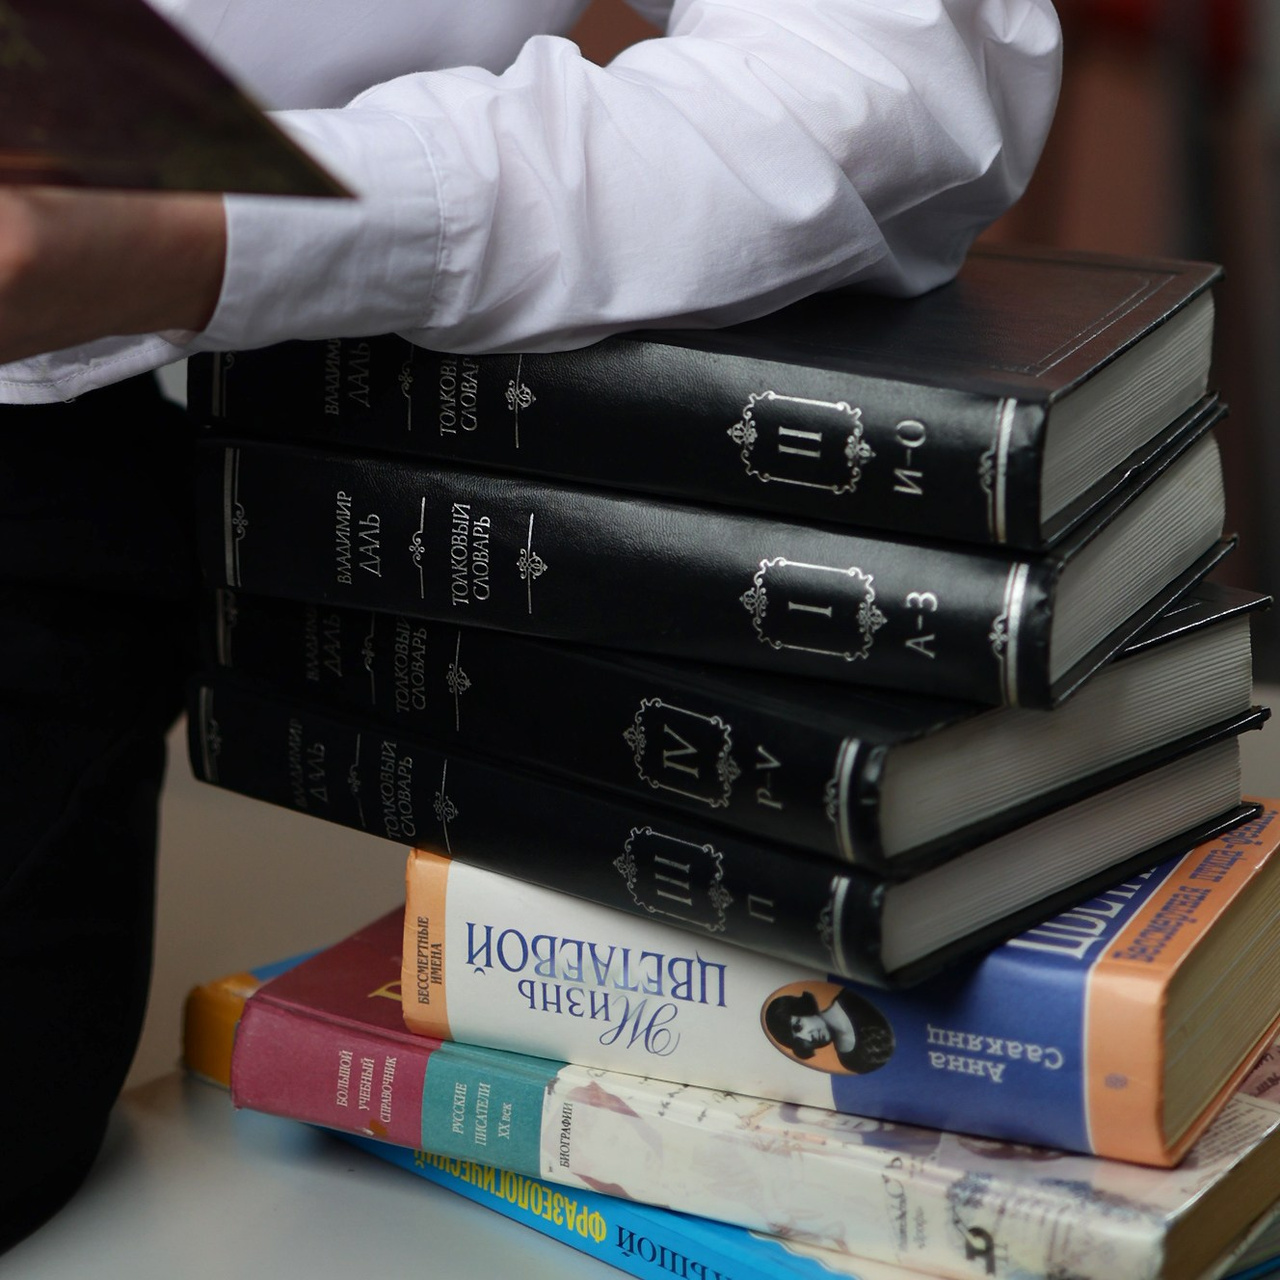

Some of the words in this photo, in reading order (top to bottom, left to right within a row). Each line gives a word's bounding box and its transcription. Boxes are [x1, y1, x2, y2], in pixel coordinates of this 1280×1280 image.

[347, 342, 372, 409] ДАЛЬ
[438, 358, 458, 437] ТОЛКОВ
[335, 490, 353, 585] ВЛАДИМИР
[358, 513, 383, 578] ДАЛЬ
[450, 502, 471, 607] ТОЛКОВЫЙ
[471, 515, 492, 602] СЛОВАРЬ
[410, 626, 428, 711] СЛОВАРЬ
[662, 723, 700, 780] IV
[379, 739, 402, 839] ТОЛКОВЫЙ
[397, 755, 417, 839] СЛОВАРЬ
[653, 853, 693, 907] III
[417, 915, 430, 1005] БЕССМЕРТНЫЕ
[431, 942, 443, 986] ИМЕНА
[464, 921, 729, 1008] ЦВЕТАЕВОЙ
[336, 1049, 354, 1108] БОЛЬШОЙ
[926, 1023, 1064, 1070] Саакянц
[927, 1050, 1007, 1084] Анна
[358, 1057, 375, 1111] УЧЕБНЫЙ
[379, 1056, 398, 1123] СПРАВОЧНИК
[451, 1082, 468, 1136] РУССКИЕ
[474, 1082, 491, 1147] ПИСАТЕЛИ
[558, 1102, 573, 1169] БИОГРАФИИ
[615, 1224, 733, 1280] ЬШОЙ
